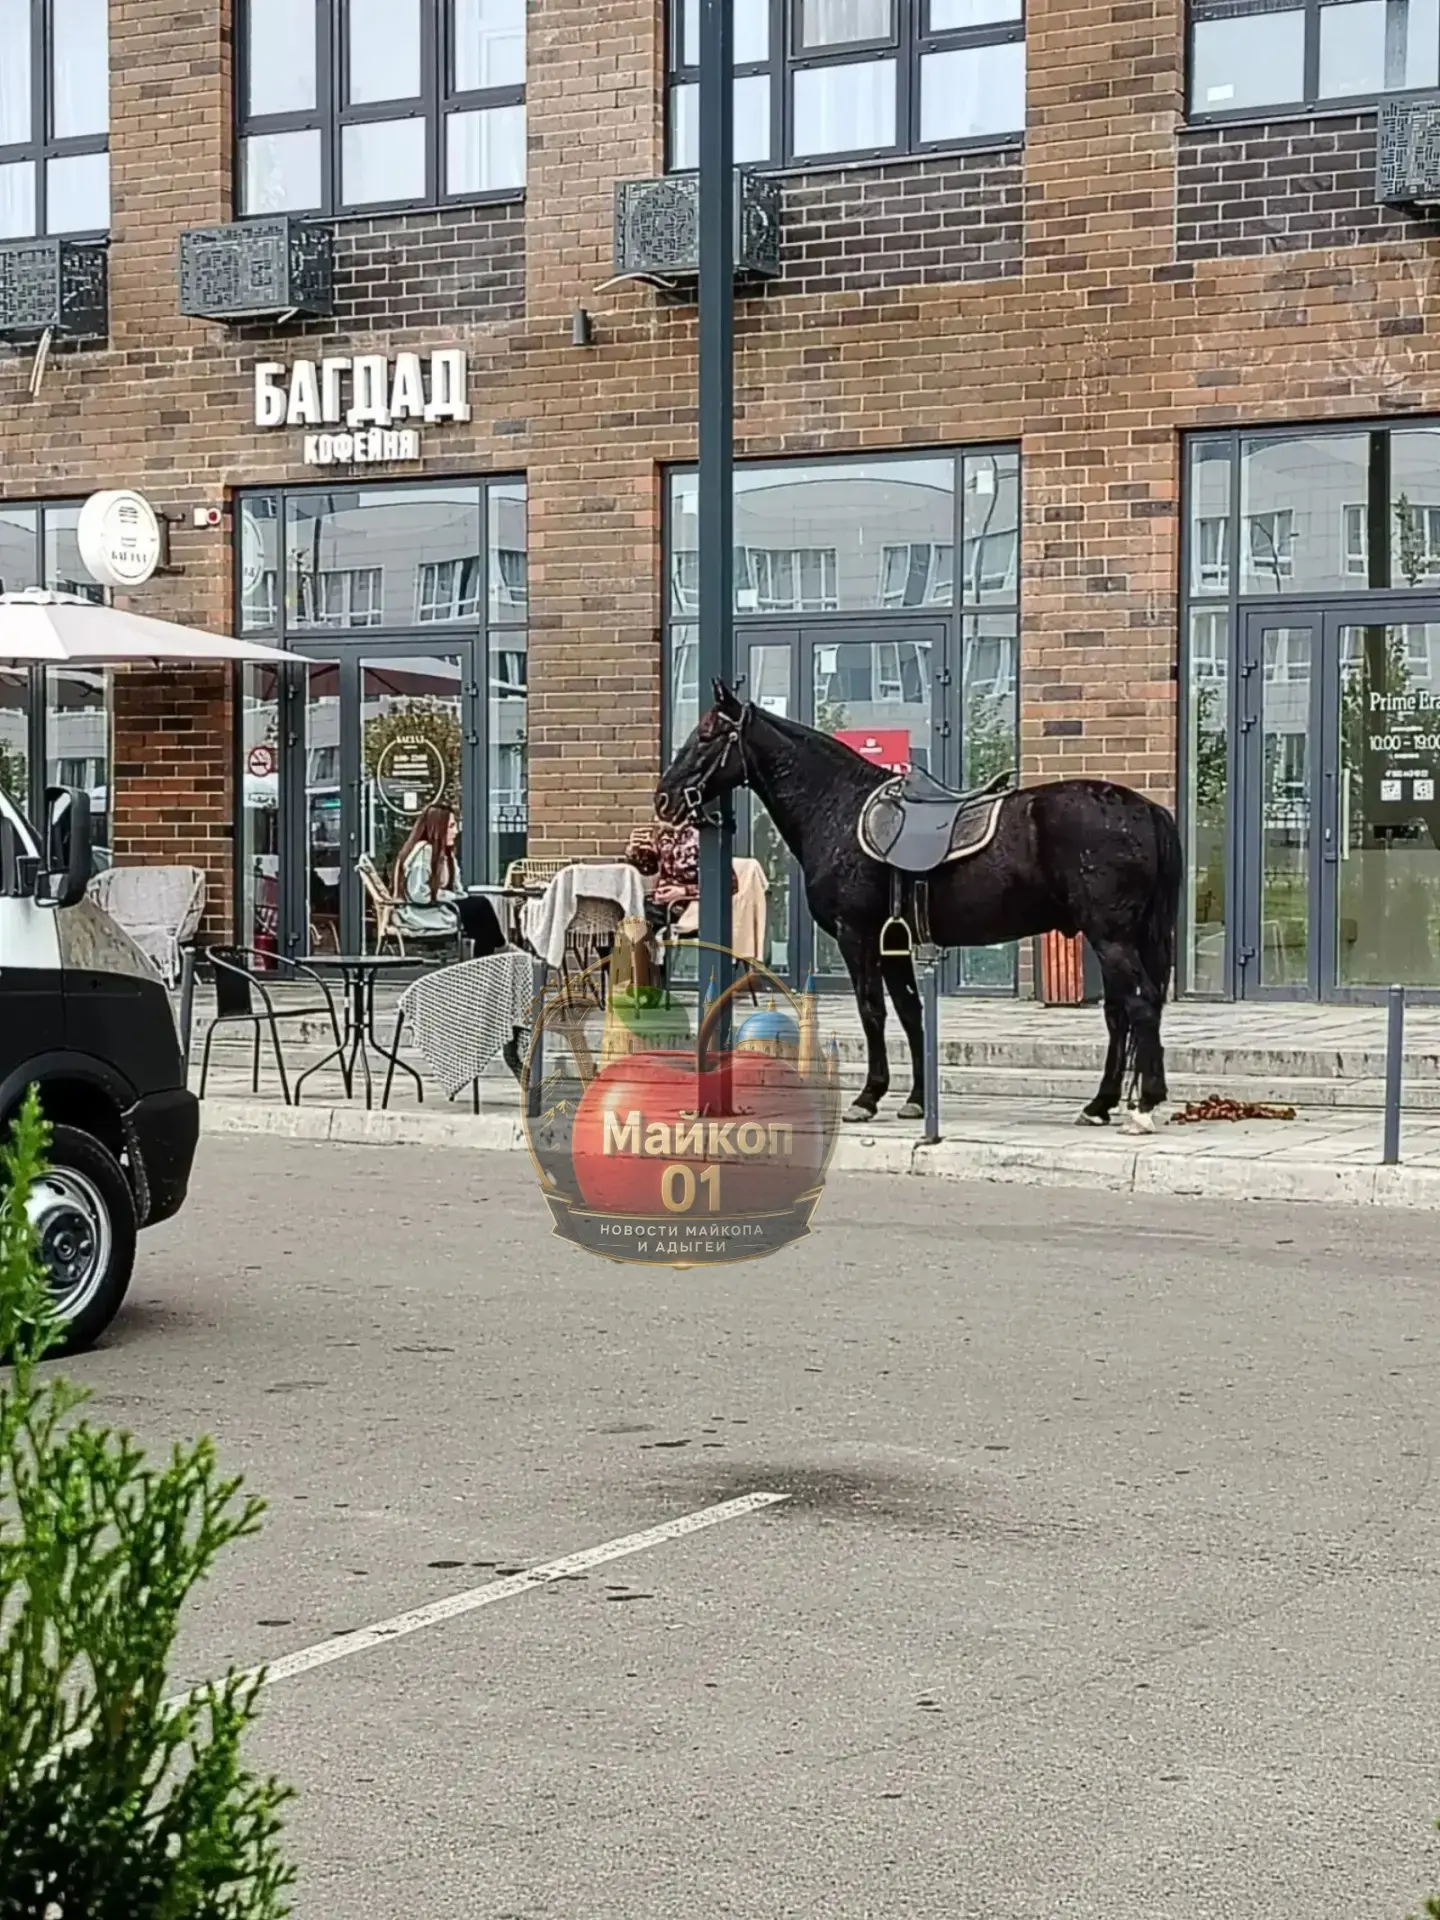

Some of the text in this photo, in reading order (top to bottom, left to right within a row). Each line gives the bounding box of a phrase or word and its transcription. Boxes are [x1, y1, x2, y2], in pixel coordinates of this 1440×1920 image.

[255, 349, 472, 427] БАГДАД
[304, 427, 420, 465] КОФЕЙНЯ
[1370, 691, 1416, 711] Prime
